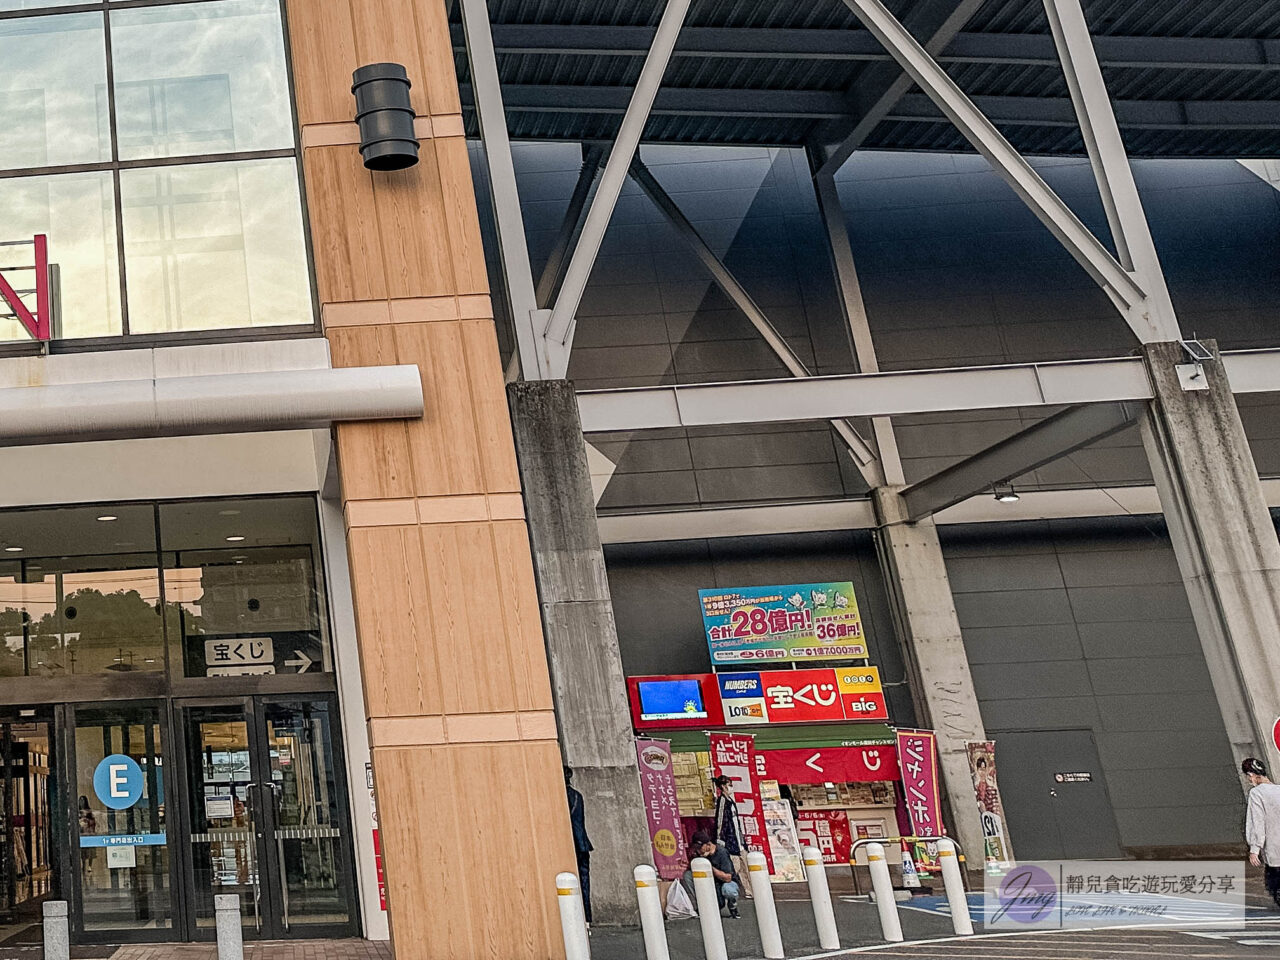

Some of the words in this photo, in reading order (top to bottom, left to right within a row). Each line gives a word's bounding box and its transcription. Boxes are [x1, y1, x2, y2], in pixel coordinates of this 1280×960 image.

[213, 642, 264, 661] 宝くじ
[724, 679, 758, 690] NUMBERS
[767, 683, 837, 709] 宝くじ
[110, 764, 130, 798] E
